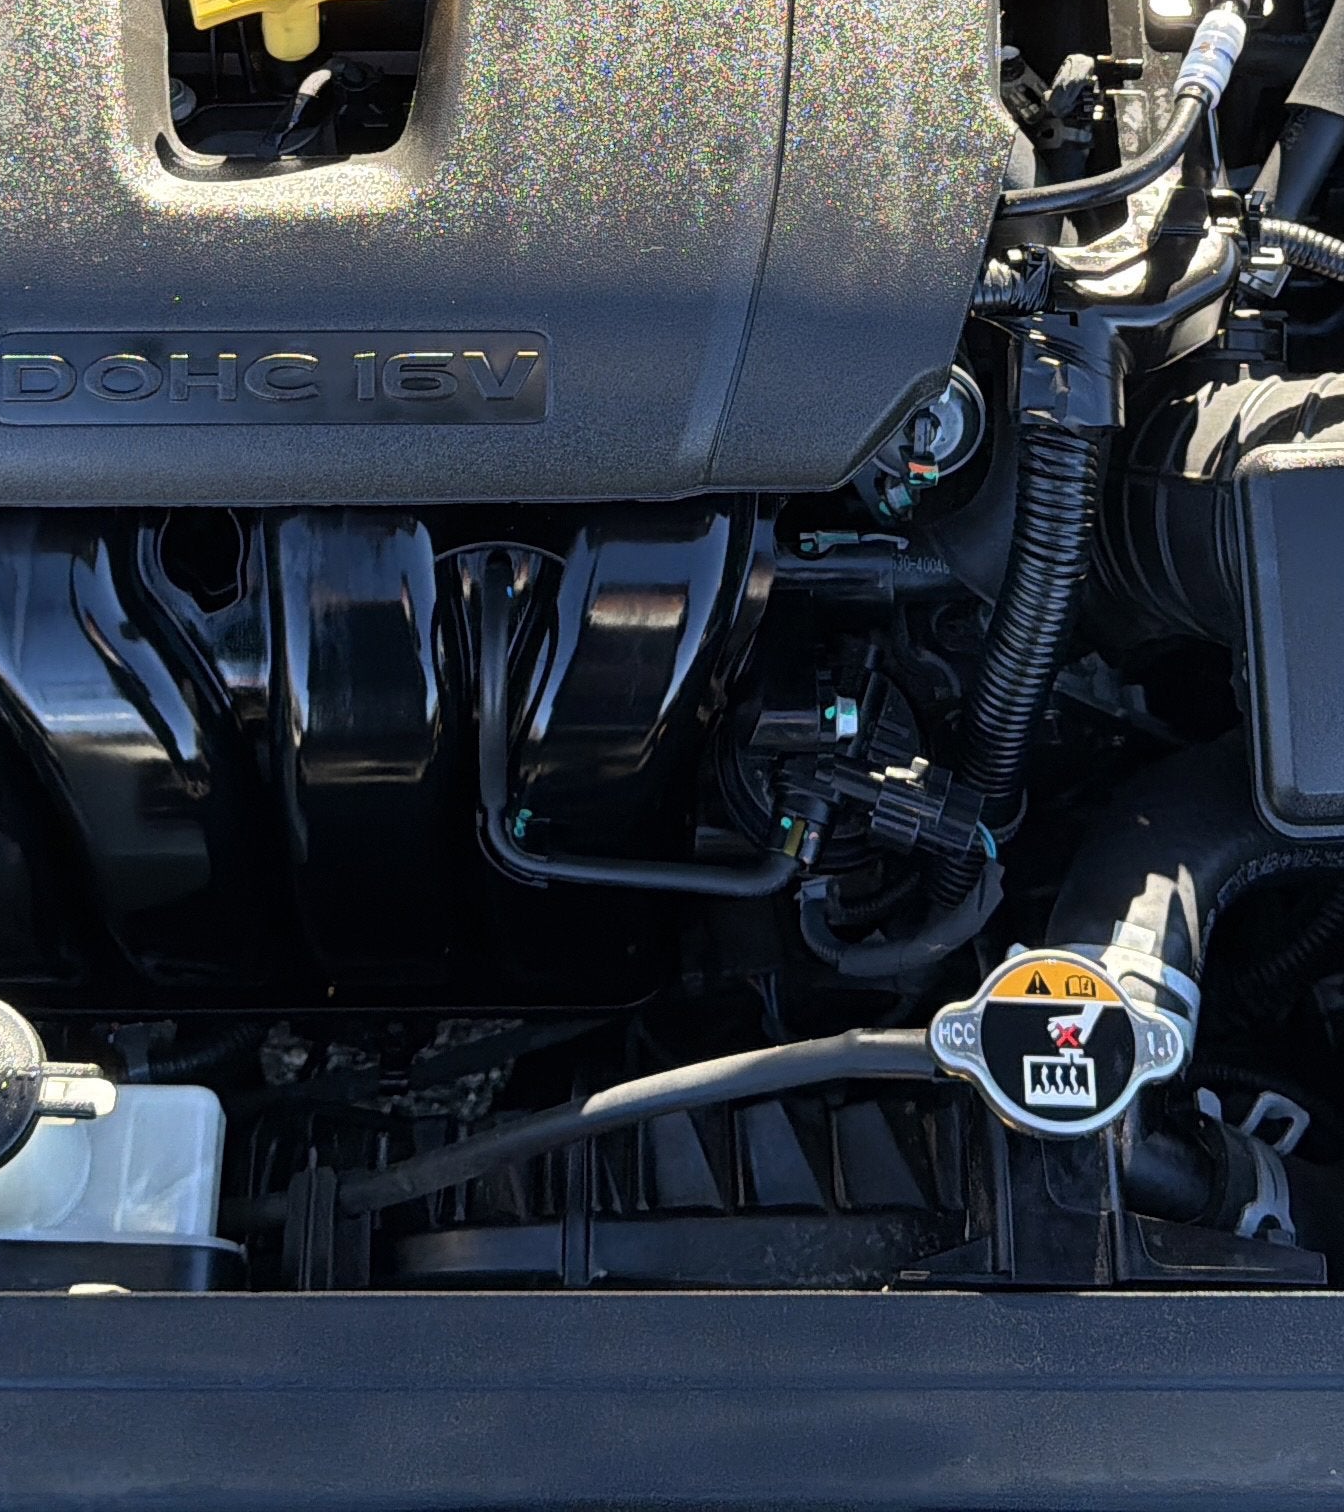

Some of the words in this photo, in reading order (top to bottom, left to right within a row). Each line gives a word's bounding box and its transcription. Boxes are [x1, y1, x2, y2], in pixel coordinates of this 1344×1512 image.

[2, 352, 320, 402] DOHC
[353, 350, 538, 401] 16V
[938, 1022, 976, 1045] HCC
